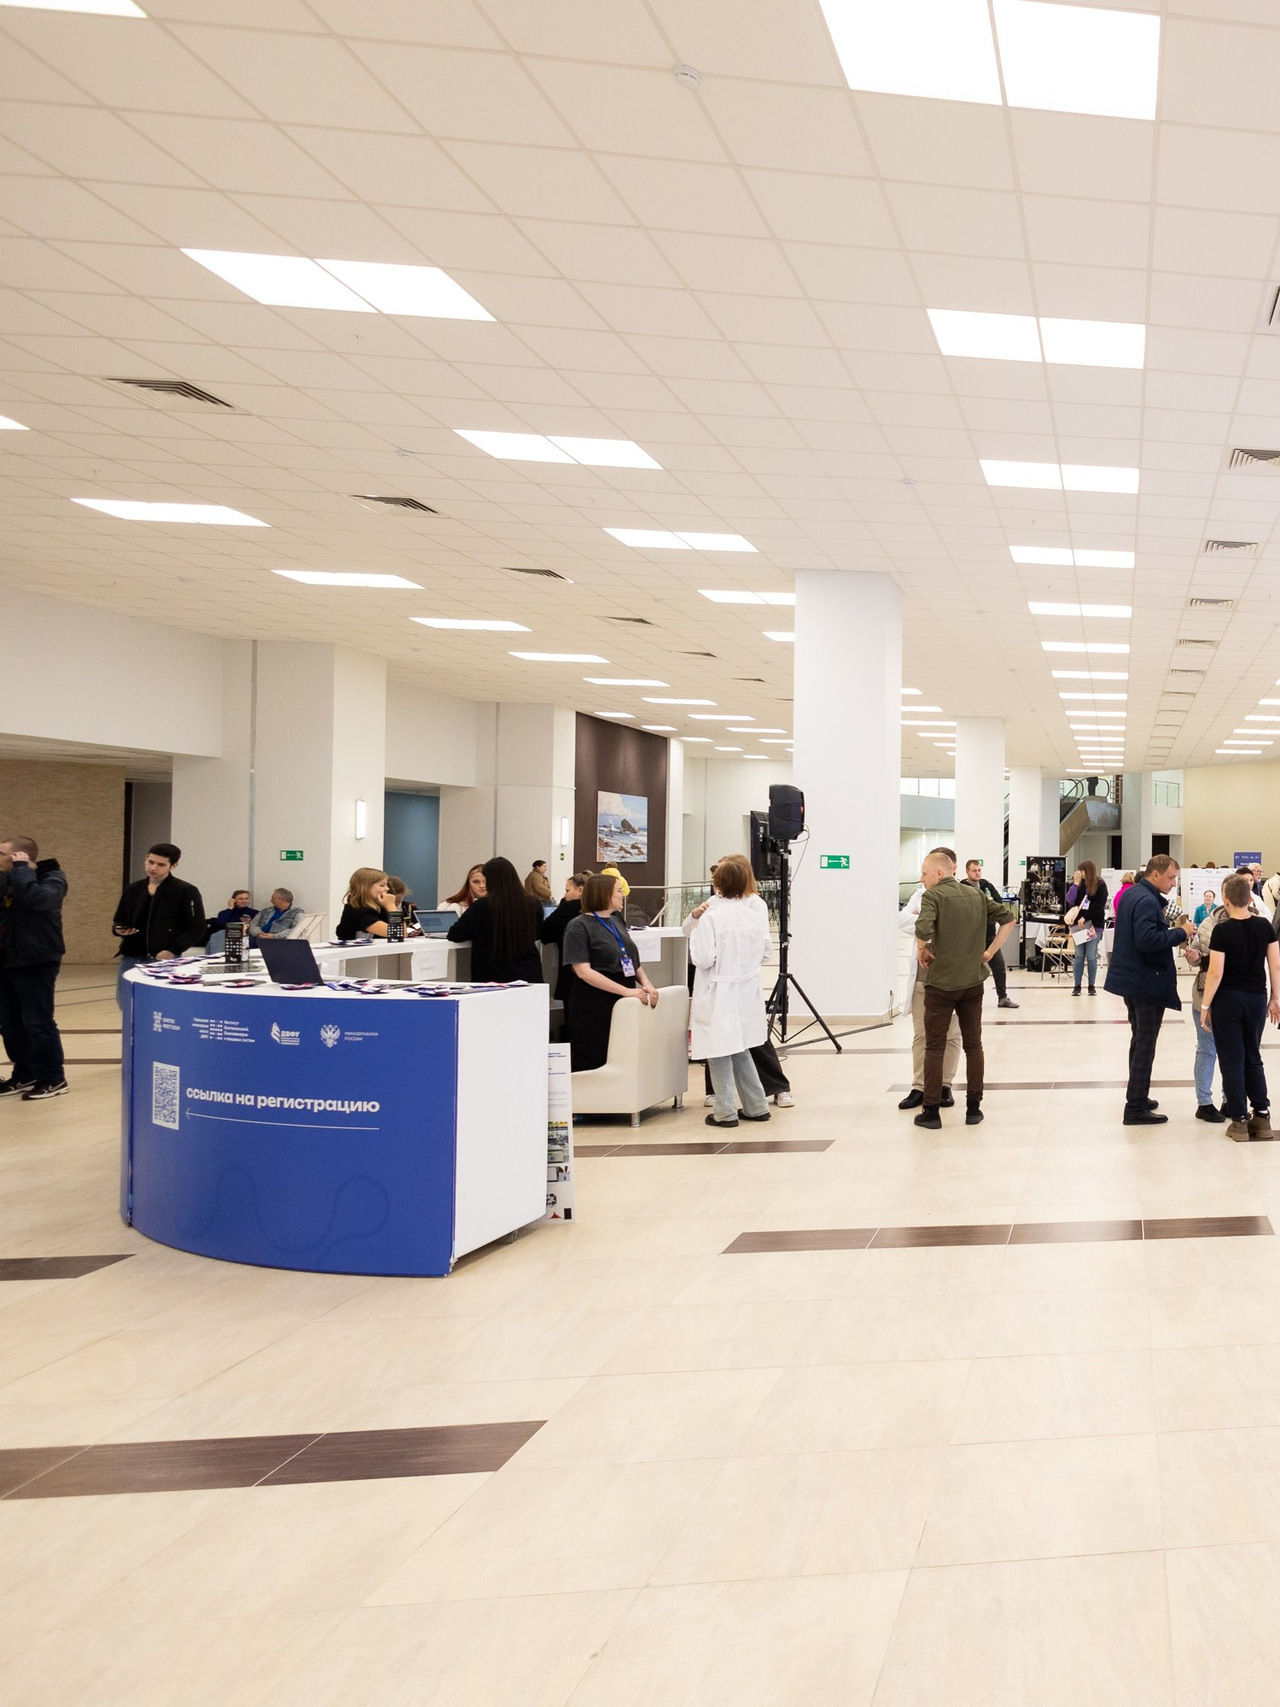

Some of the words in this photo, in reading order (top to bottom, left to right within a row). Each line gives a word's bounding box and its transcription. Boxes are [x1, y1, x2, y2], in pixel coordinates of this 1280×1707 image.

[186, 1087, 233, 1104] ссылка
[235, 1093, 254, 1106] на
[257, 1095, 380, 1114] регистрацию
